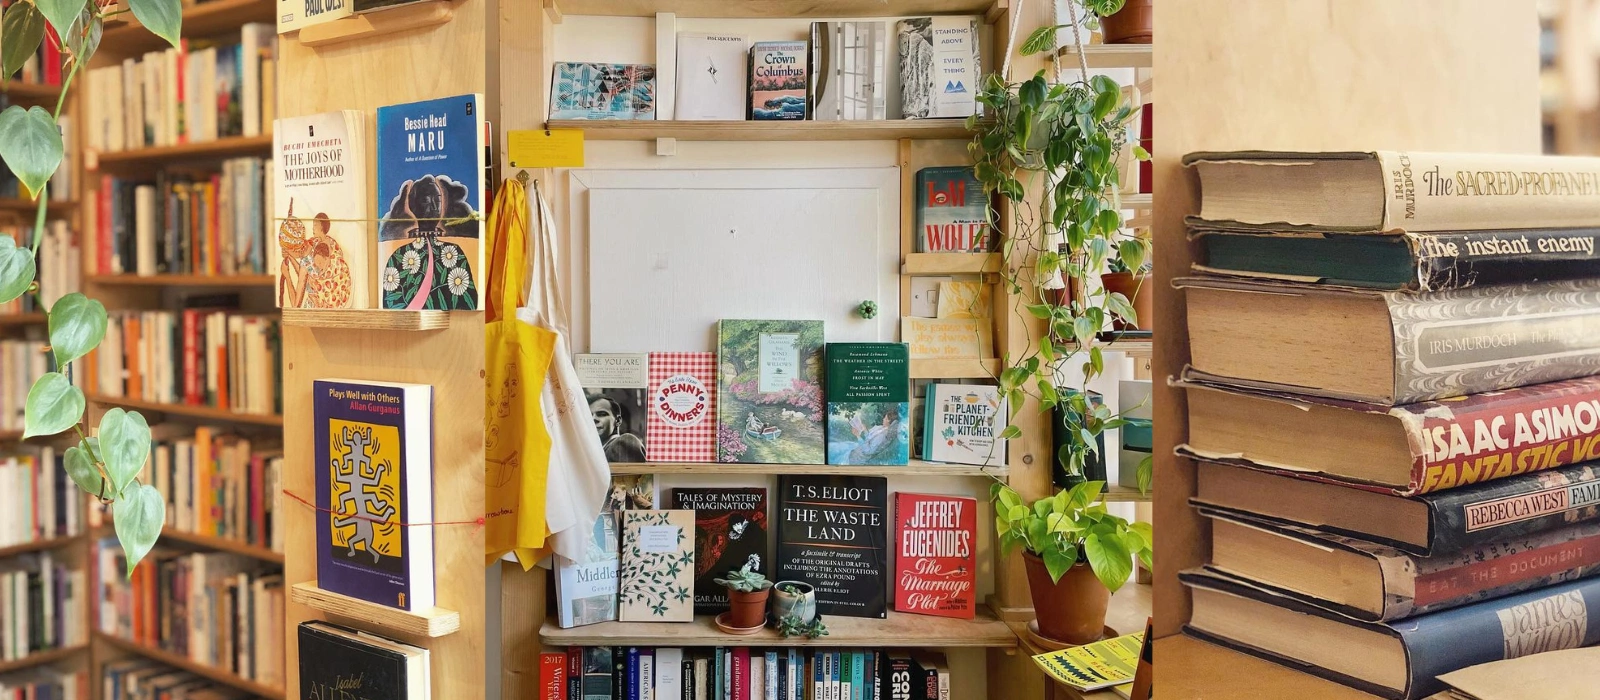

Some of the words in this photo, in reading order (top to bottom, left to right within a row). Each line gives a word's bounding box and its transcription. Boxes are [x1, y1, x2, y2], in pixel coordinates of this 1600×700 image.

[765, 54, 796, 64] Crown
[756, 65, 804, 77] Columbus
[404, 115, 428, 130] Bessie
[430, 112, 446, 128] Head
[307, 138, 341, 148] EMECHETA
[408, 130, 444, 152] MARU
[284, 153, 304, 166] THE
[306, 150, 328, 165] JOYS
[330, 148, 342, 162] OF
[284, 164, 344, 181] MOTHERHOOD
[1422, 165, 1453, 196] The
[1393, 170, 1404, 200] IRIS
[926, 224, 990, 251] WOLFE
[1464, 235, 1531, 255] instant
[1538, 236, 1595, 255] enemy
[1430, 340, 1452, 354] IRIS
[1455, 332, 1517, 352] MURDOCH
[329, 388, 345, 398] Plays
[346, 390, 360, 400] Well
[361, 392, 376, 401] with
[377, 393, 400, 404] Others
[662, 383, 704, 397] PENNY
[350, 402, 367, 411] Allan
[368, 403, 400, 415] Gurganus
[660, 402, 704, 422] DINNERS
[956, 404, 990, 414] PLANET-
[944, 414, 985, 426] FRIENDLY
[958, 426, 992, 437] KITCHEN
[1422, 416, 1509, 462] ISAAC
[1421, 442, 1567, 493] FANTASTIC
[678, 492, 703, 502] TALES
[706, 494, 718, 502] OF
[721, 492, 762, 502] MYSTERY
[693, 501, 755, 510] IMAGINATION
[1471, 498, 1530, 526] REBECCA
[1530, 490, 1566, 514] WEST
[1572, 484, 1600, 504] FAMI
[784, 508, 818, 523] THE
[823, 511, 880, 526] WASTE
[912, 502, 962, 528] JEFFREY
[808, 526, 855, 541] LAND
[903, 530, 970, 558] EUGENIDES
[1430, 577, 1458, 594] EAT
[1471, 567, 1497, 582] THE
[1510, 547, 1584, 575] DOCUMENT
[901, 574, 970, 598] Marriage
[907, 593, 946, 610] Plot
[1504, 590, 1586, 637] James
[334, 672, 364, 691] Isabel
[892, 672, 900, 700] CRI
